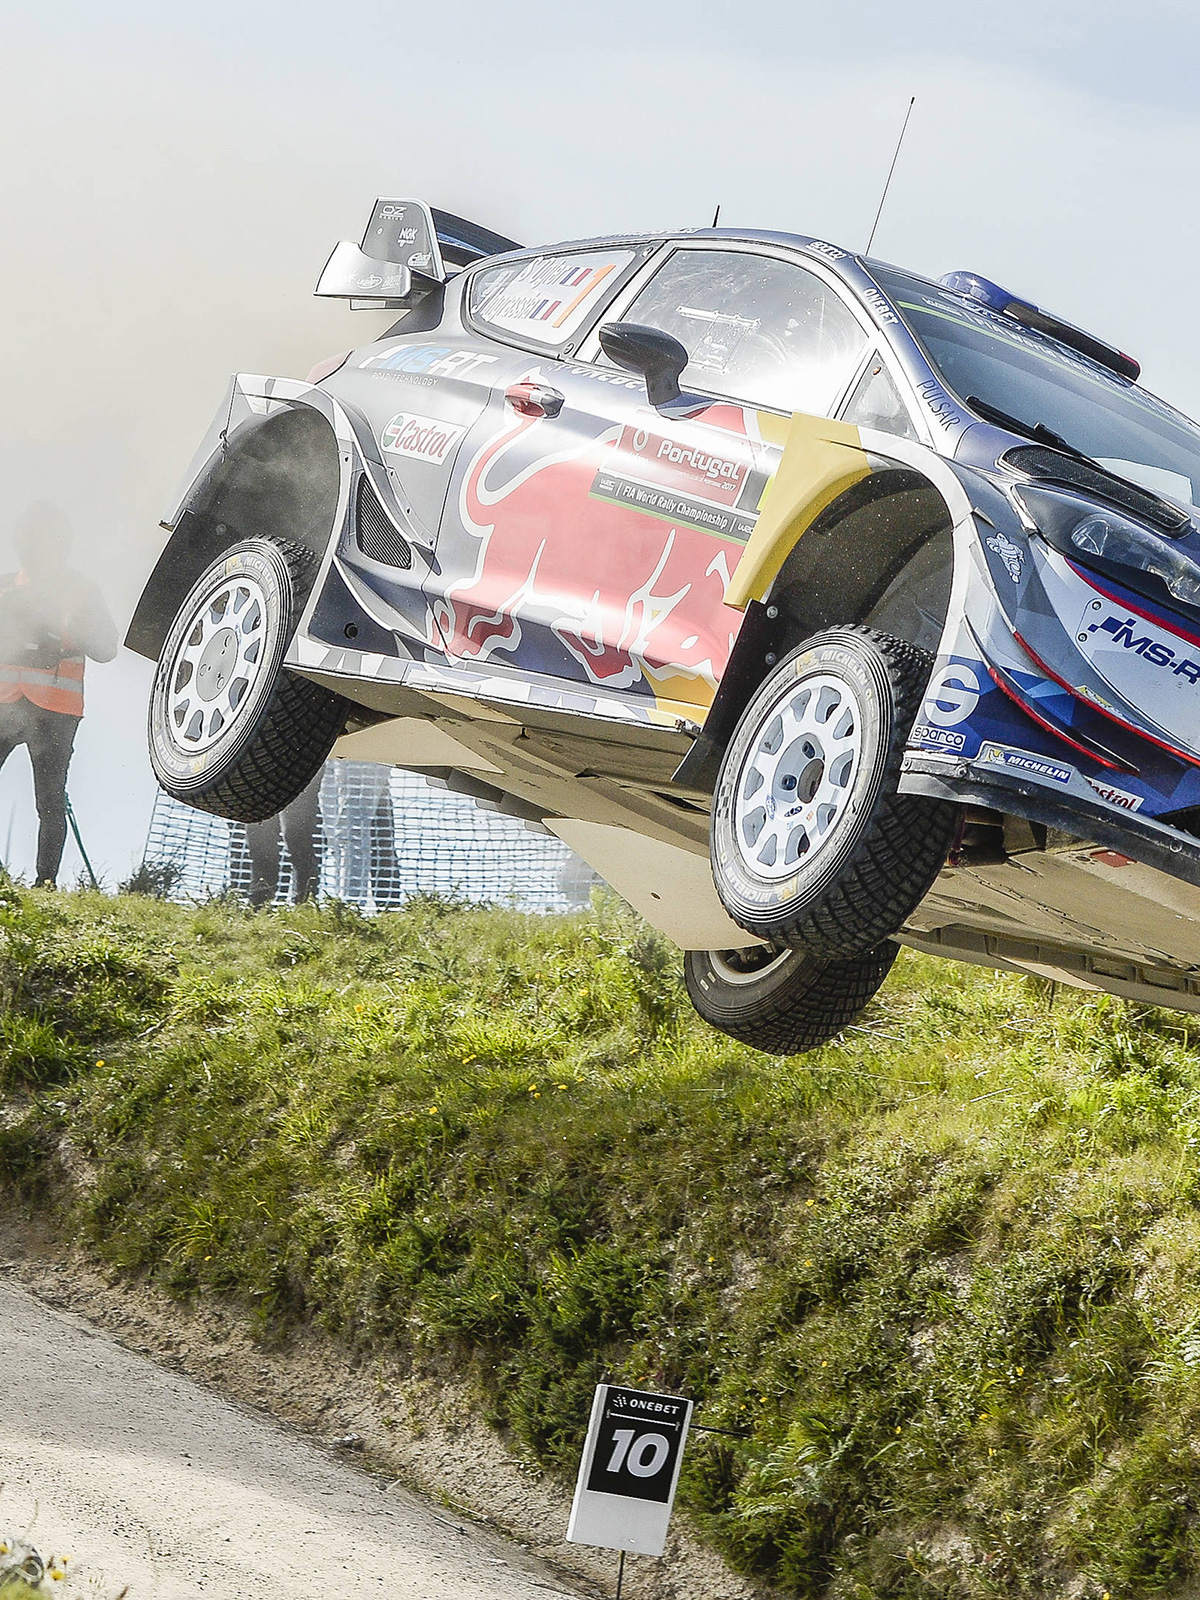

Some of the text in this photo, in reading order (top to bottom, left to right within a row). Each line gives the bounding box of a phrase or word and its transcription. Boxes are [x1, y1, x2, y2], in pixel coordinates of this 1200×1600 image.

[399, 228, 418, 240] NGK
[392, 374, 439, 386] TECHNOLOGY
[916, 380, 961, 431] PULSAR
[394, 419, 457, 458] Castrol
[657, 439, 742, 480] Portugal
[720, 482, 736, 491] 2017
[622, 485, 636, 499] FIA
[636, 489, 658, 506] World
[656, 496, 677, 514] Rally
[676, 502, 729, 530] Championship
[820, 650, 868, 685] MICHELIN
[914, 725, 964, 747] sparco
[1007, 754, 1070, 781] MICHELIN
[630, 1399, 680, 1415] ONEBET
[606, 1429, 669, 1478] 10
